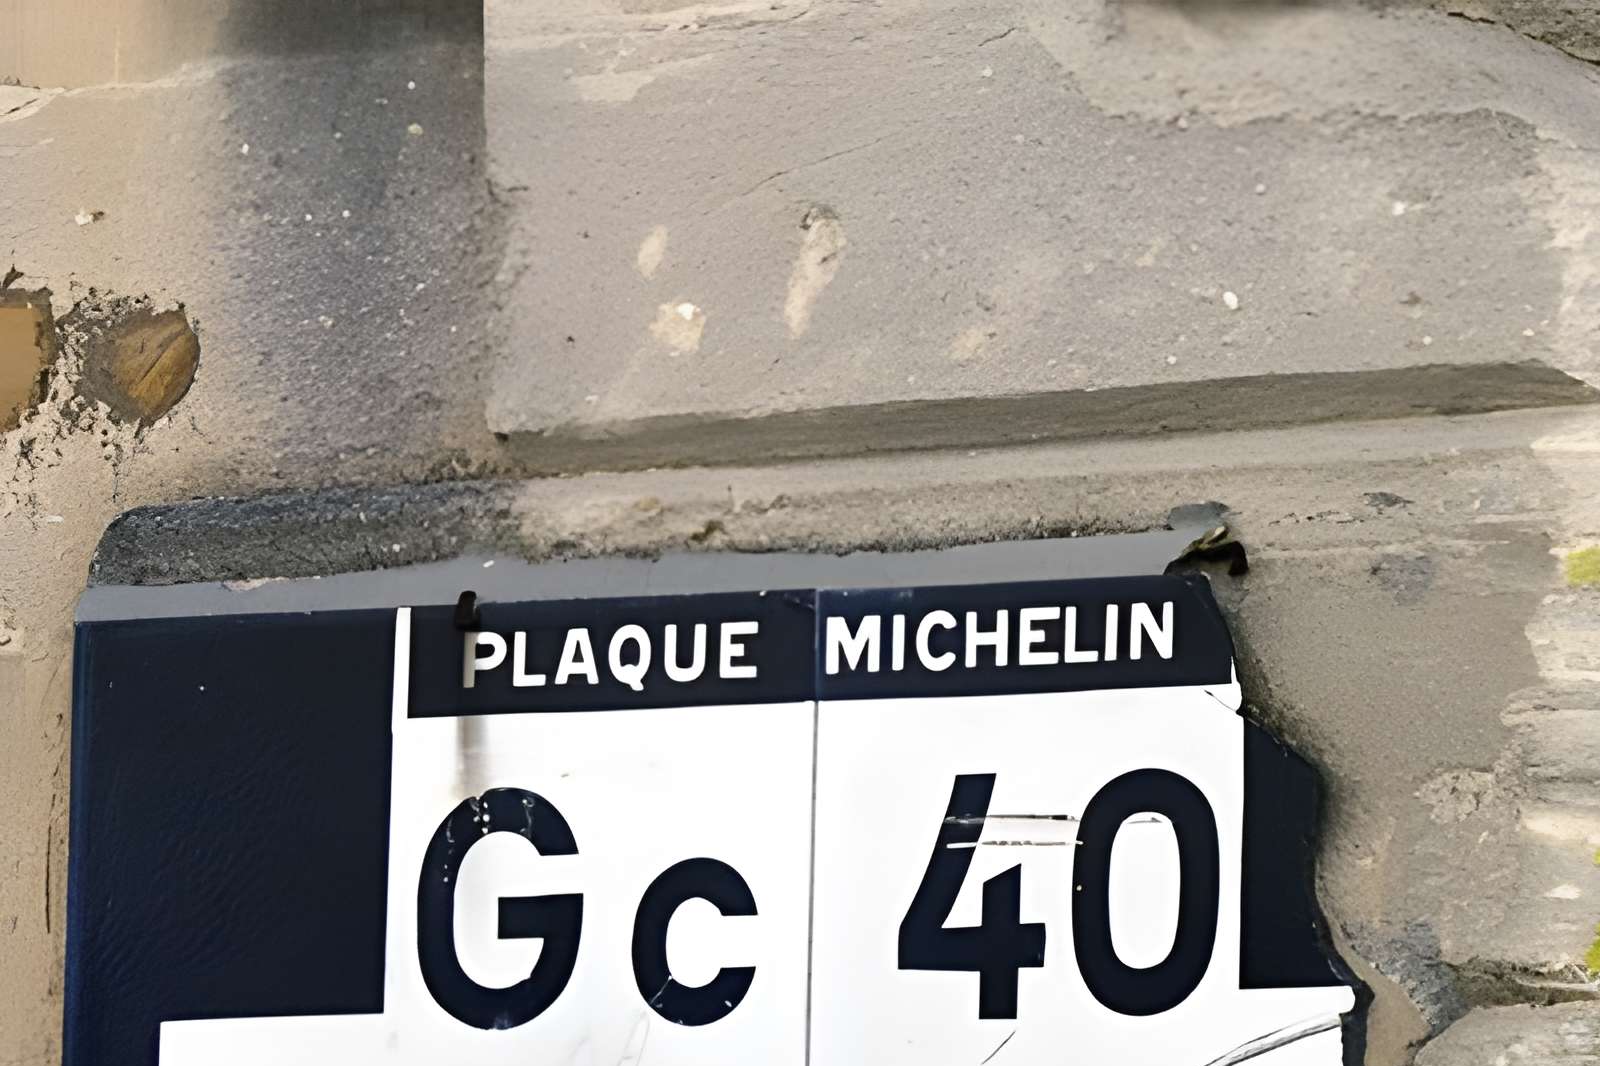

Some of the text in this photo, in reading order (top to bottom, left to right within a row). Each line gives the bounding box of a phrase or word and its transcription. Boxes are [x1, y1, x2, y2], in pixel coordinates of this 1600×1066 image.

[463, 602, 1174, 691] PLAQUE MICHELIN
[417, 768, 1219, 1030] Gc 40
